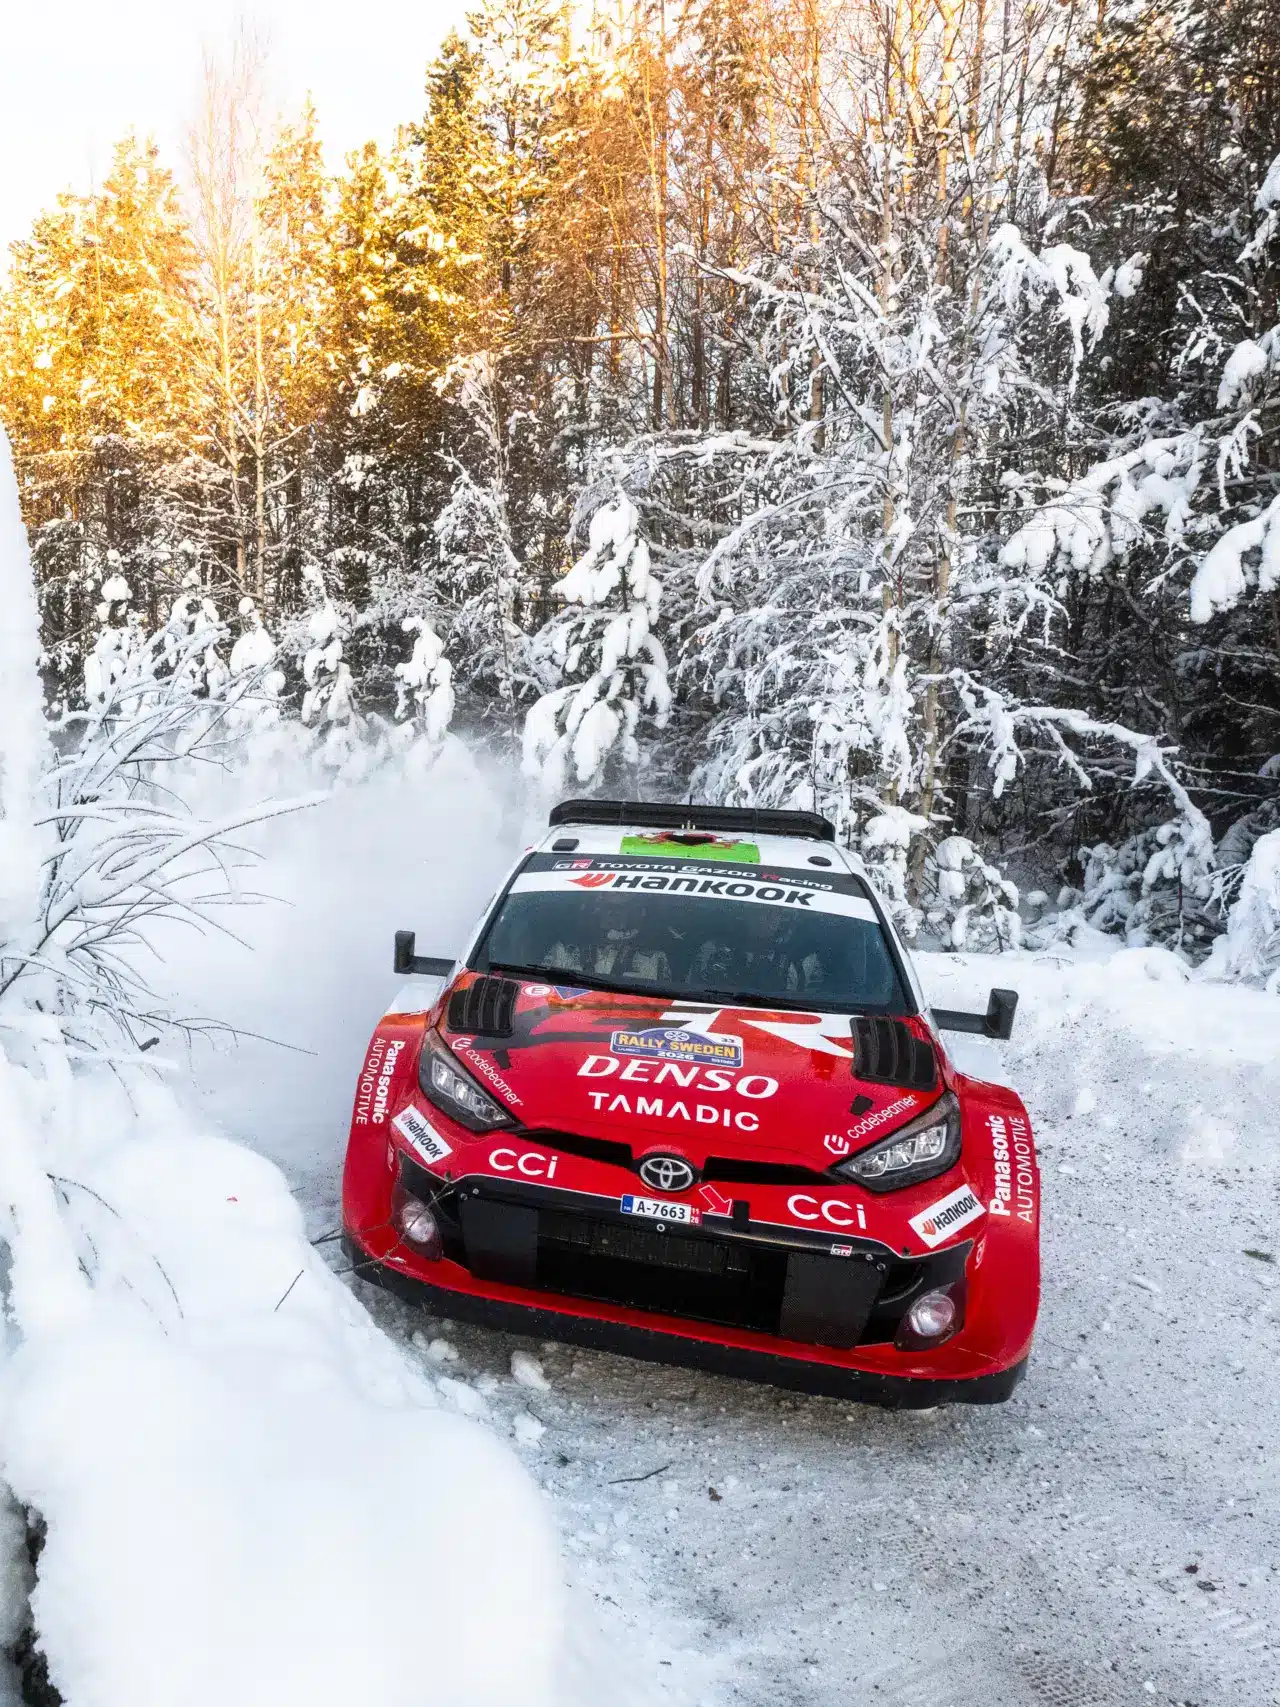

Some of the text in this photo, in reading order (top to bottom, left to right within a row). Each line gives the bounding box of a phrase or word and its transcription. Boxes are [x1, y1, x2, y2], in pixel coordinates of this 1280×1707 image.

[597, 862, 676, 871] TOYOTA
[761, 872, 834, 891] Racing
[619, 1034, 736, 1059] RALLY SWEDEN
[657, 1050, 695, 1061] 2026
[356, 1037, 386, 1125] AUTOMOTIVE
[372, 1040, 406, 1124] Panasonic
[465, 1049, 521, 1104] codebeamer
[577, 1055, 780, 1099] DENSO
[587, 1091, 760, 1131] TAMADIC
[847, 1094, 917, 1139] codebeamer
[984, 1115, 1011, 1217] Panasonic
[1008, 1115, 1034, 1224] AUTOMOTIVE
[637, 1201, 686, 1220] A-7663
